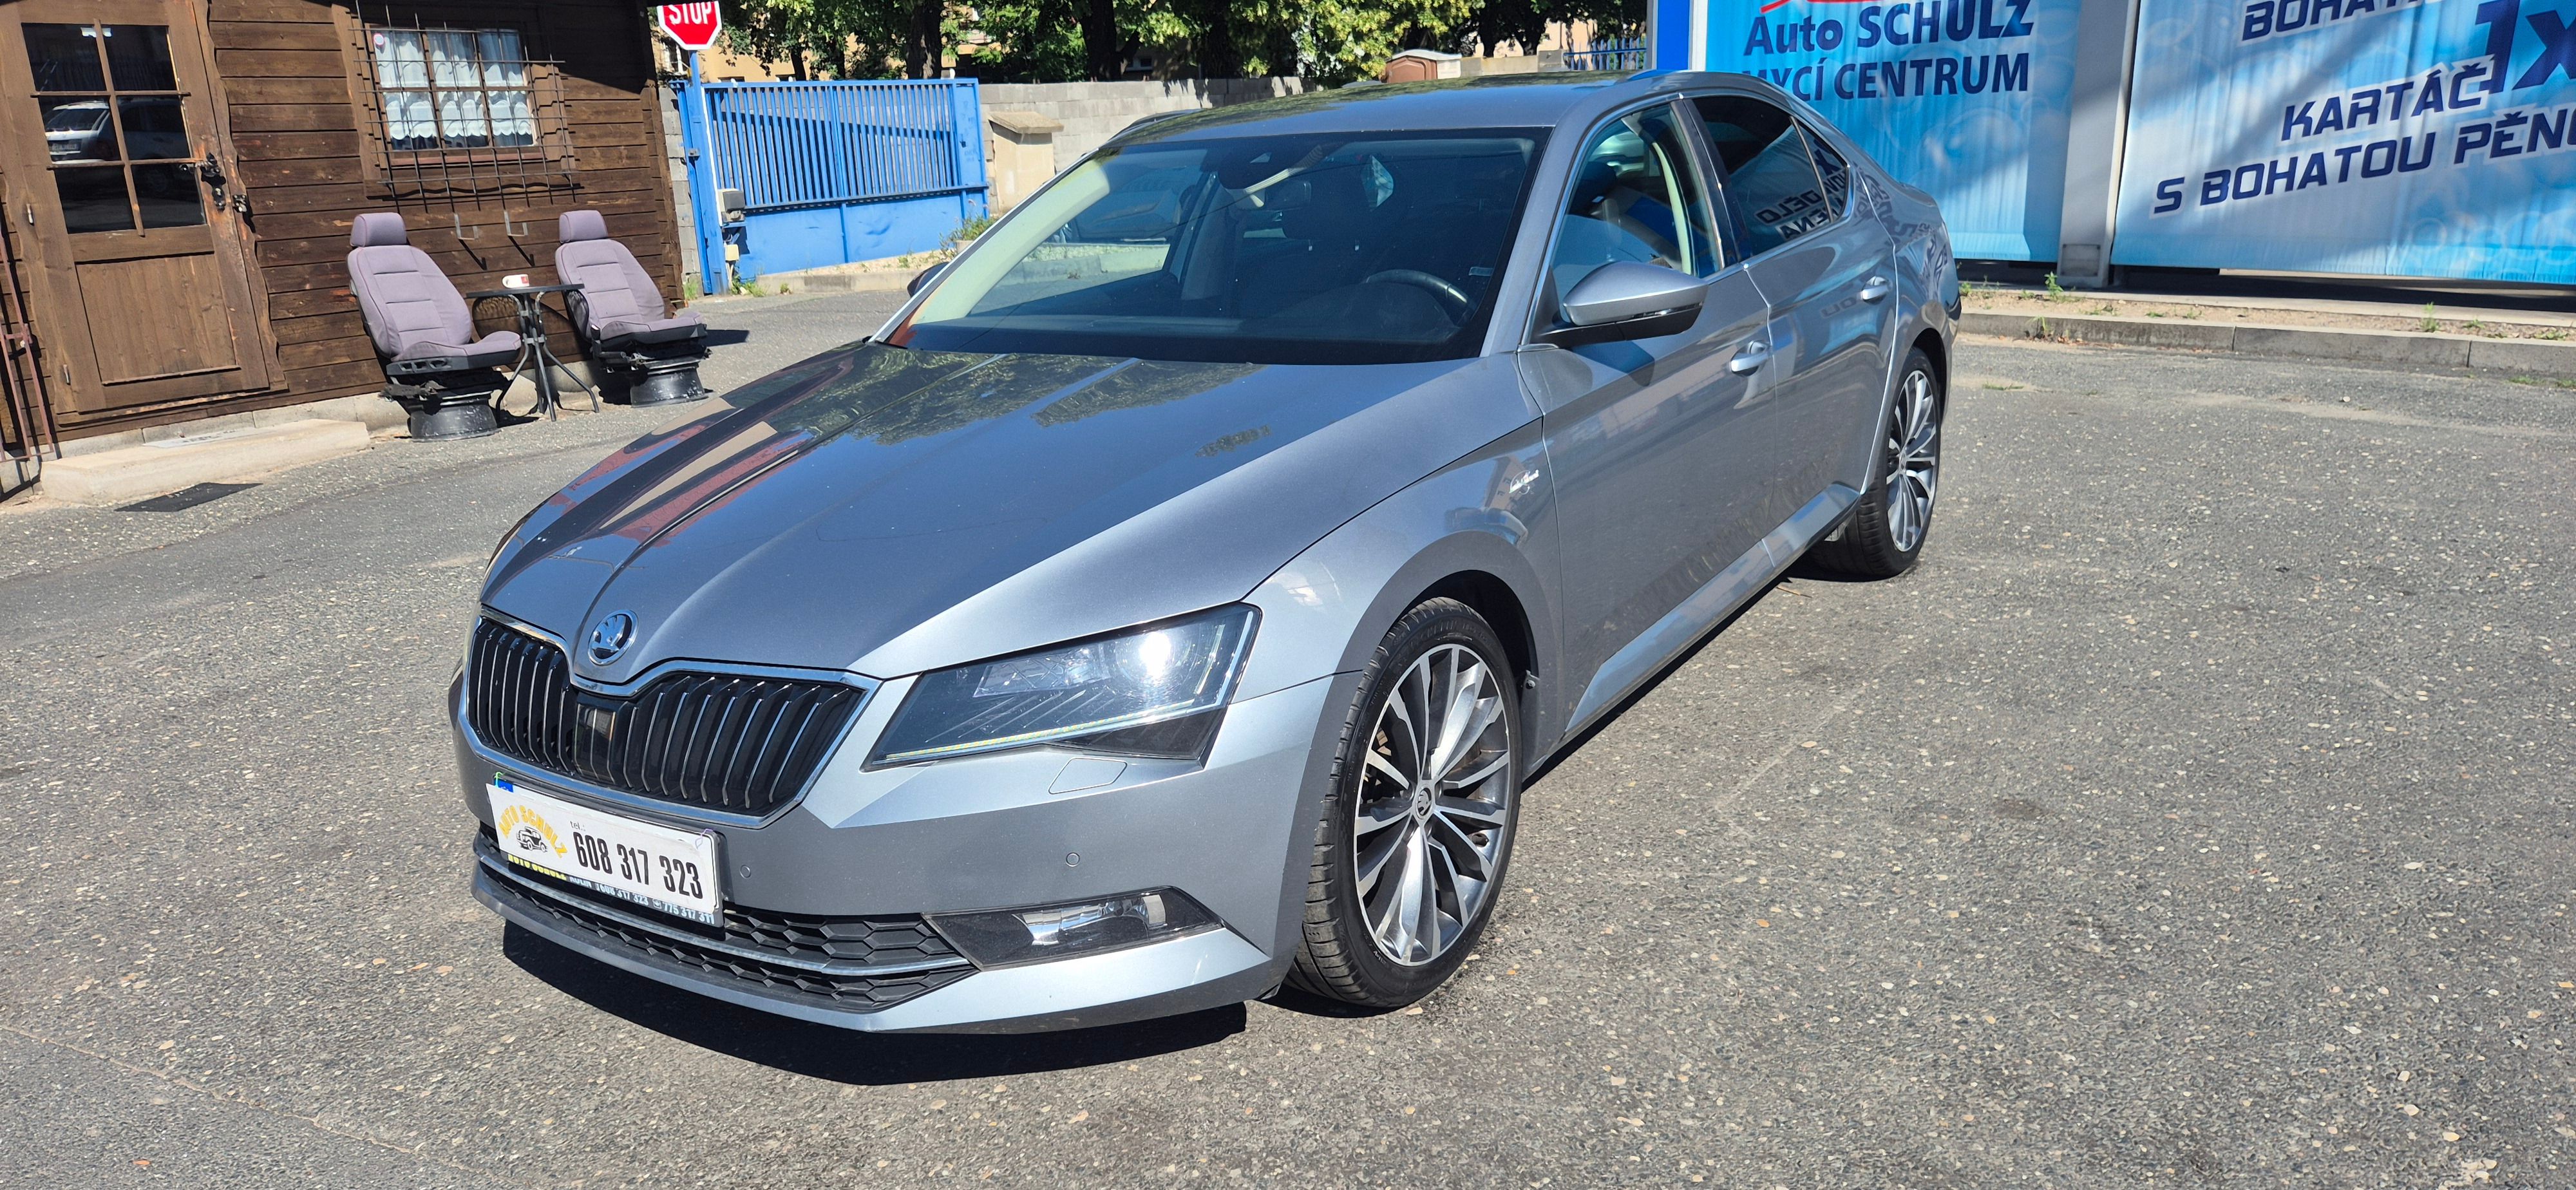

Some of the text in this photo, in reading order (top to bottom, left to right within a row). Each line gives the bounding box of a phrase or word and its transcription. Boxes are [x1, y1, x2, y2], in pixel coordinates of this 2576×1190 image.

[668, 2, 712, 25] STOP
[1743, 0, 2034, 56] Auto SCHULZ
[1742, 53, 2029, 102] YCÍ CENTRUM
[2281, 62, 2487, 141] KARTÁČ
[2154, 108, 2576, 214] S BOHATOU PĚN
[498, 805, 567, 858] AUTO SCHULZ
[573, 831, 703, 899] 608 317 323
[632, 892, 649, 906] 323
[663, 902, 679, 915] 775
[680, 907, 696, 920] 317
[698, 912, 715, 925] 311
